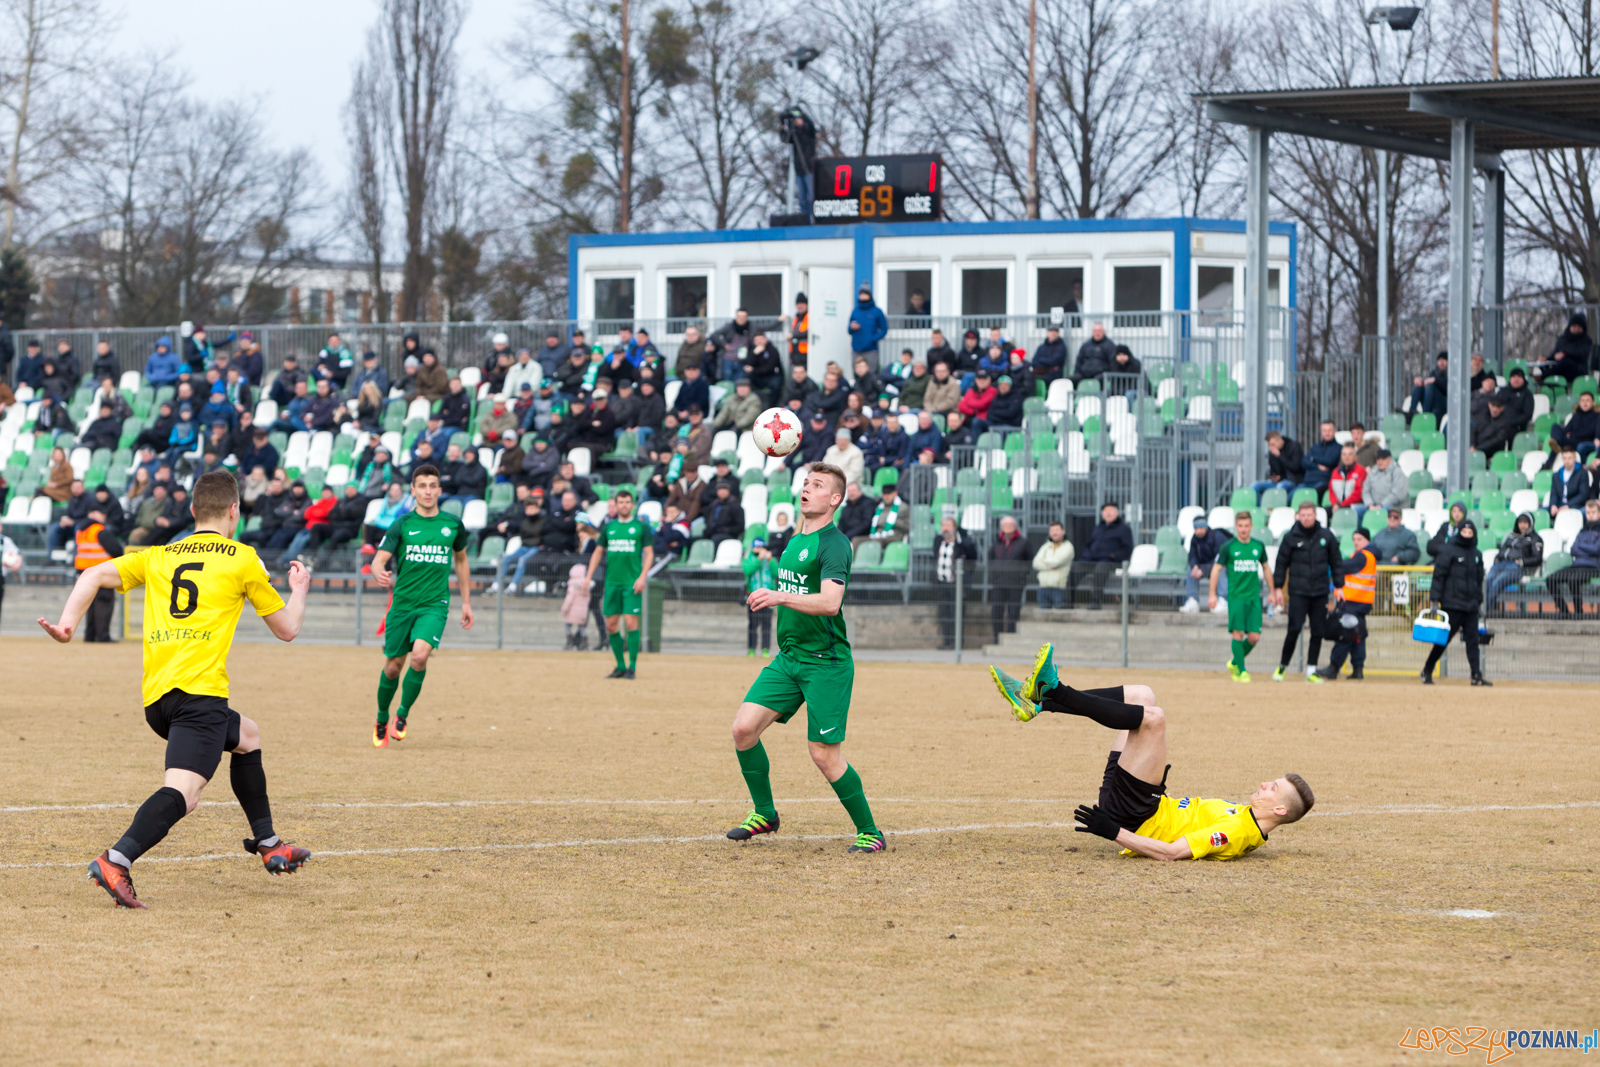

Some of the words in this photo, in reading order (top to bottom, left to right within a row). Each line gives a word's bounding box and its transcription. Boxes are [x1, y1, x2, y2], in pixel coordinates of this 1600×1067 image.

[834, 164, 852, 197] 0
[928, 161, 937, 193] 1
[859, 185, 894, 217] 69
[405, 553, 449, 564] HOUSE
[406, 545, 450, 555] FAMILY
[778, 568, 808, 585] MILY
[170, 562, 205, 619] 6
[778, 581, 809, 595] OUSE
[1394, 580, 1407, 598] 32
[149, 628, 212, 644] SAN-TECH
